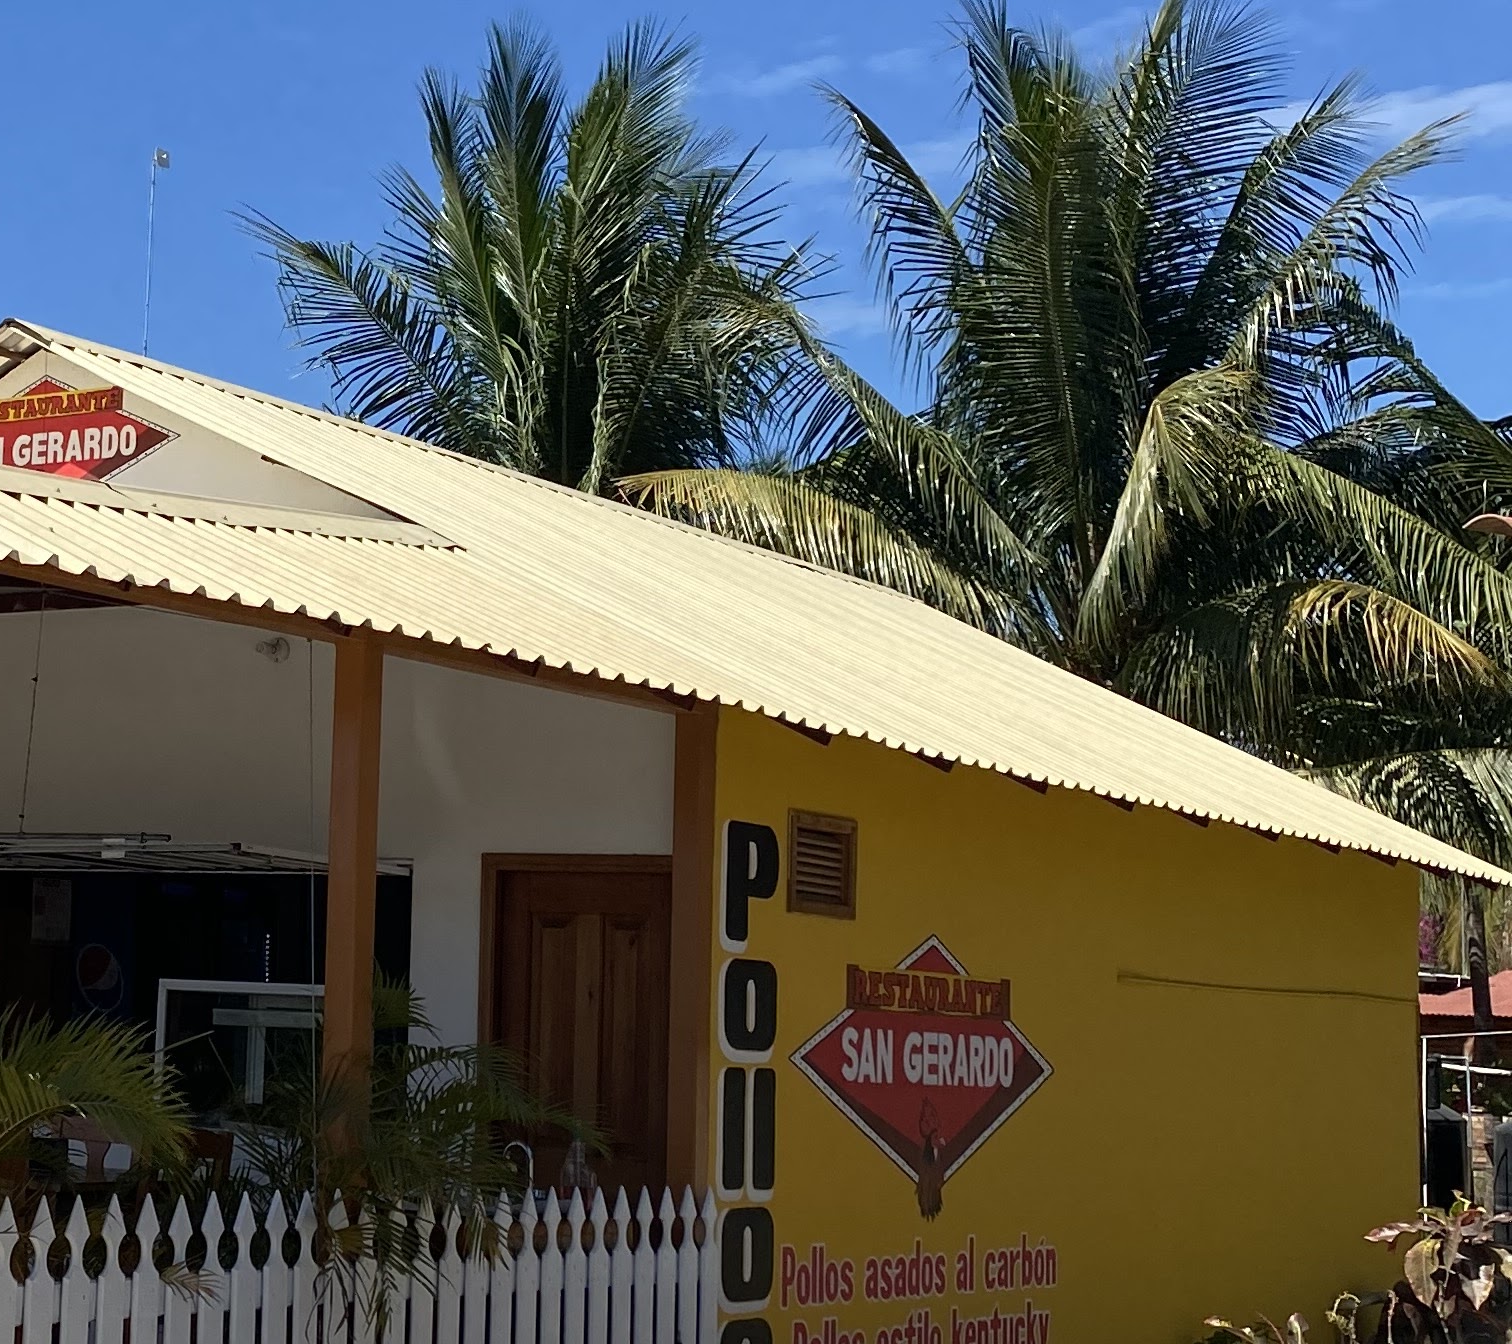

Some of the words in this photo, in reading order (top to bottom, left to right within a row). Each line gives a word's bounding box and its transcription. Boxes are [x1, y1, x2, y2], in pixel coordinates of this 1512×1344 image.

[12, 425, 137, 467] GERARDO
[852, 968, 1004, 1017] RESTAURANTE
[841, 1026, 893, 1084] SAN
[903, 1031, 1014, 1088] GERARDO
[781, 1243, 854, 1308] Pollos
[865, 1237, 946, 1300] asados
[956, 1235, 975, 1292] al
